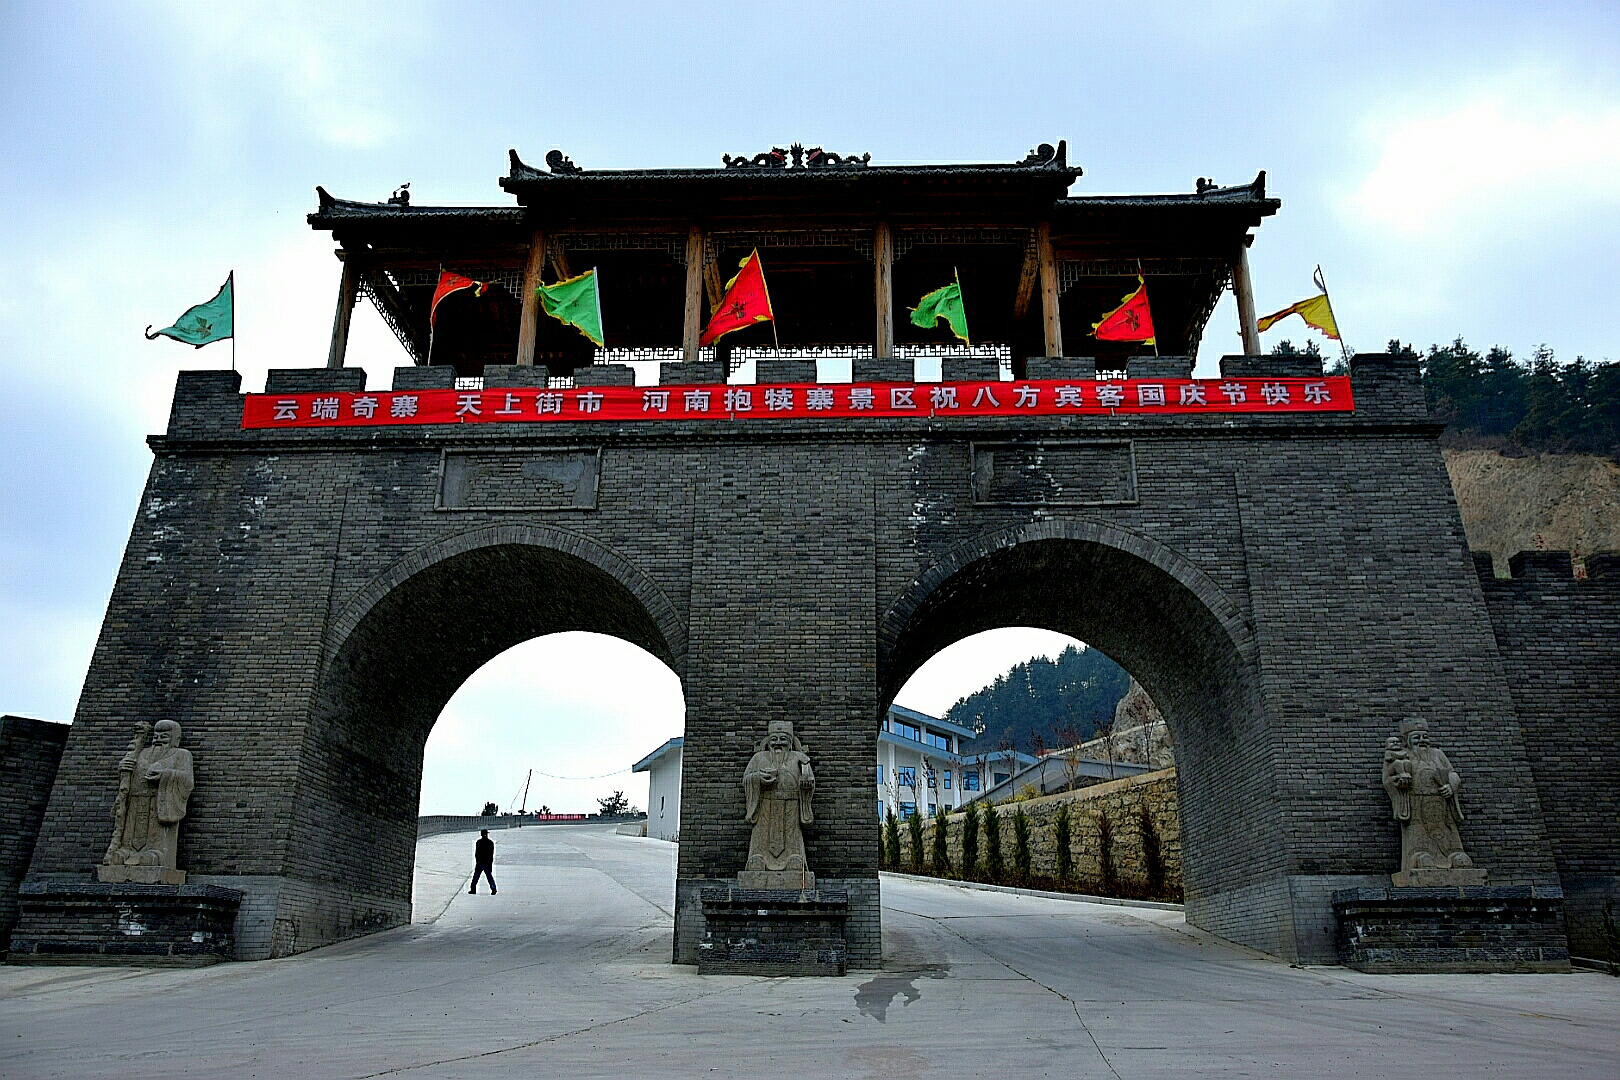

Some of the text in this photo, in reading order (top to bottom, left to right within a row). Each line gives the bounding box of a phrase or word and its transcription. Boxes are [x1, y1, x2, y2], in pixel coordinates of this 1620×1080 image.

[273, 394, 418, 421] 云端奇寨
[456, 391, 604, 416] 天上街市
